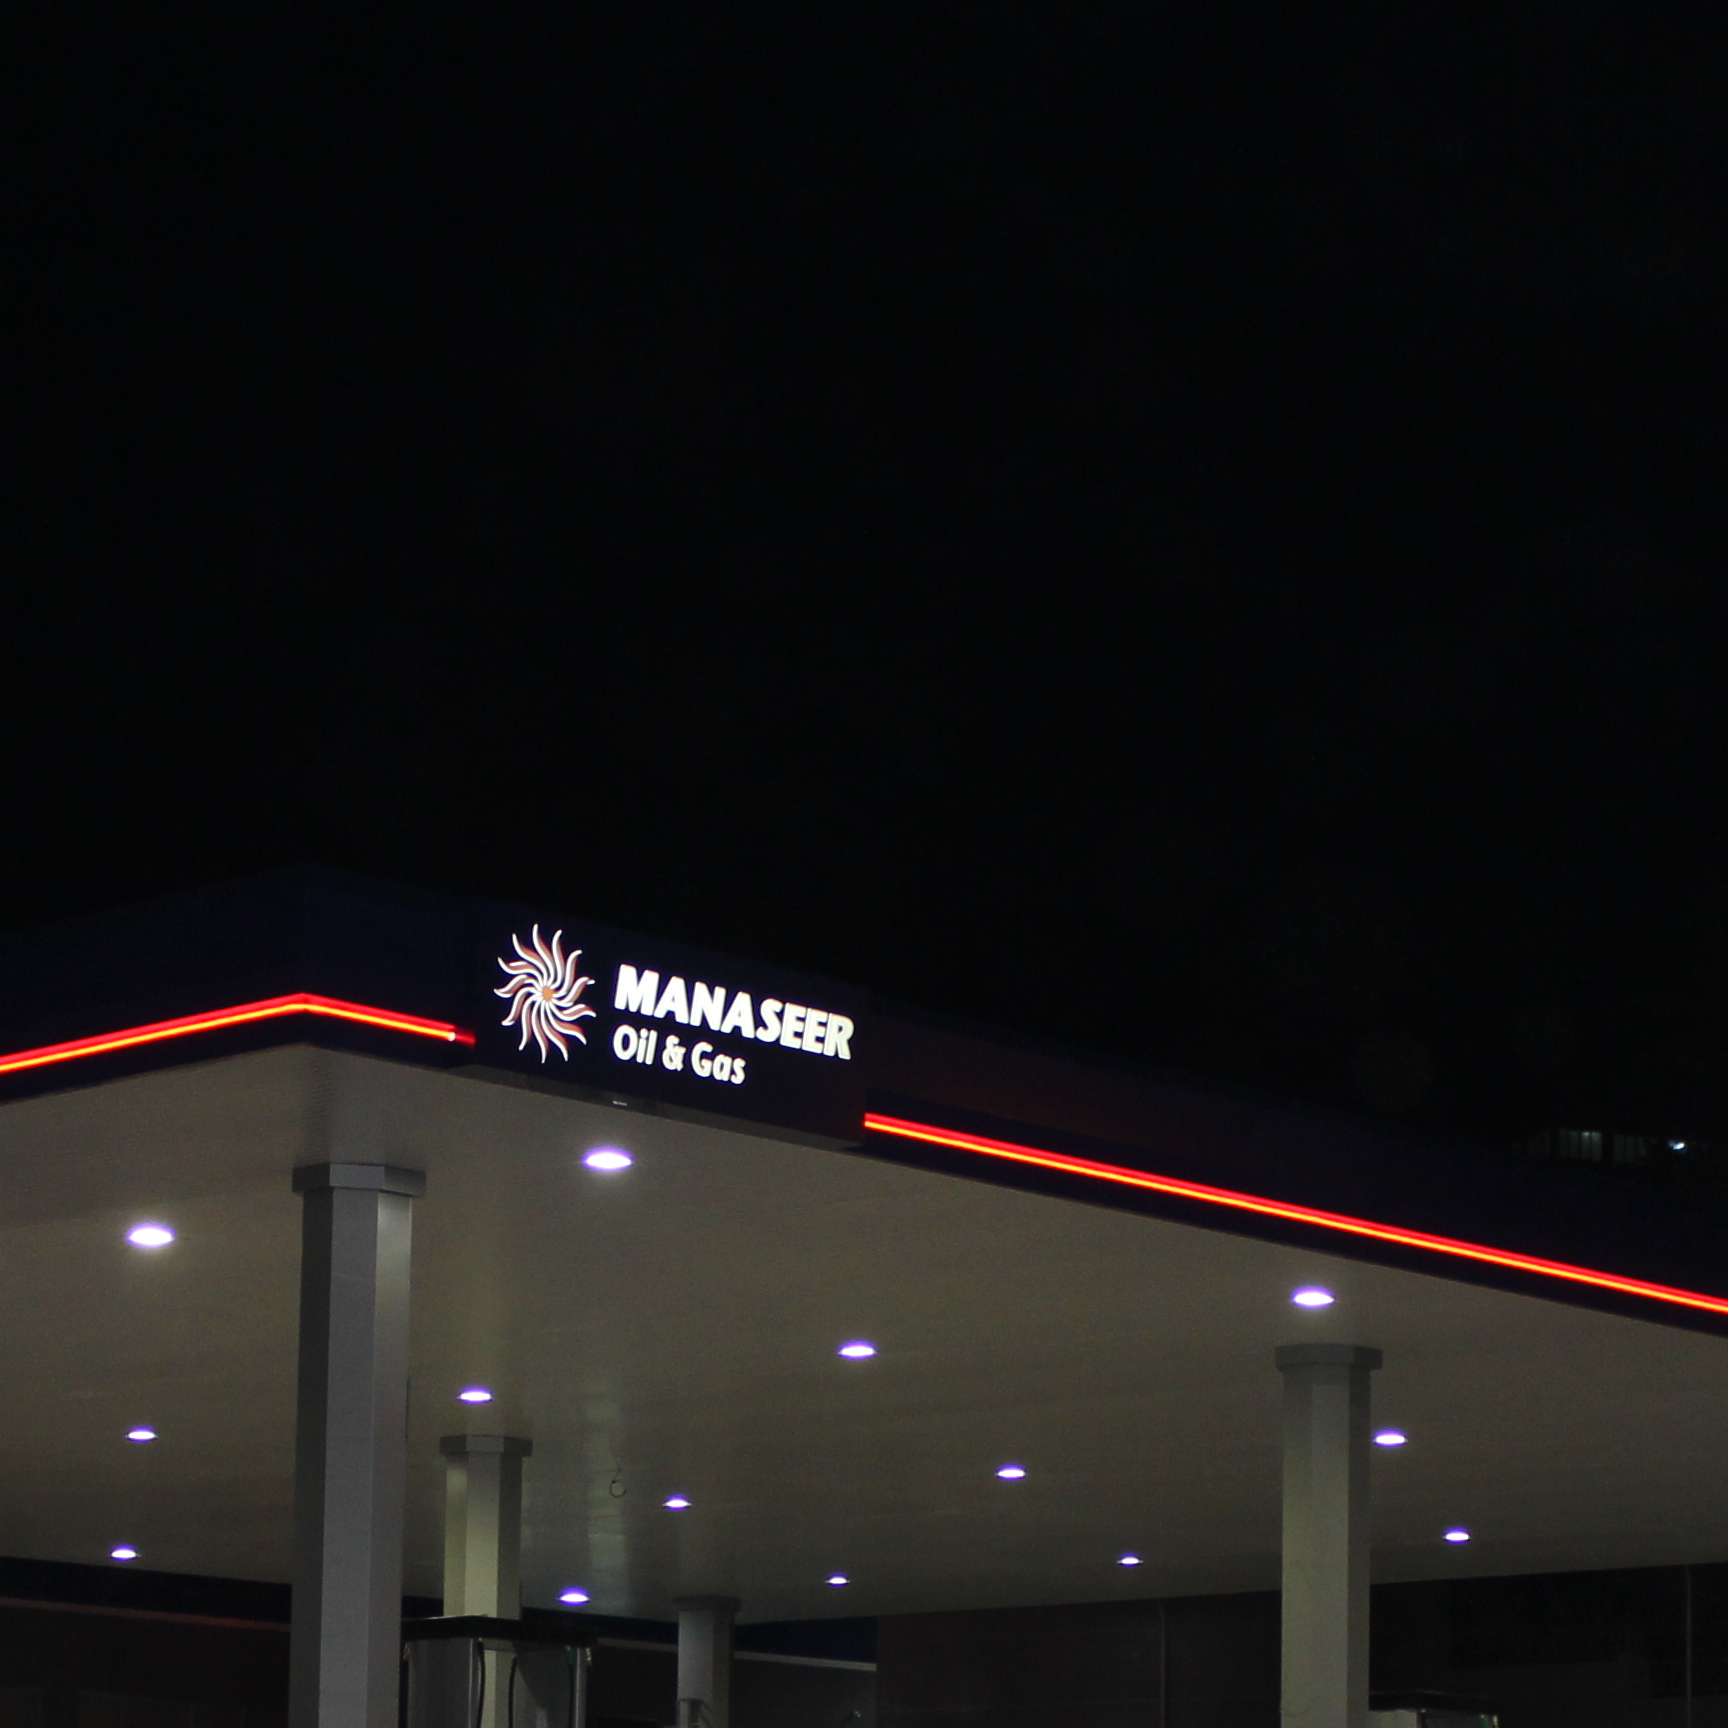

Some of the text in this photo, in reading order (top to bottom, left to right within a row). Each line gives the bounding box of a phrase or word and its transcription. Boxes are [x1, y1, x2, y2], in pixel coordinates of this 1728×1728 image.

[614, 964, 854, 1060] MANASEER
[613, 1025, 745, 1084] Oil & Gas
